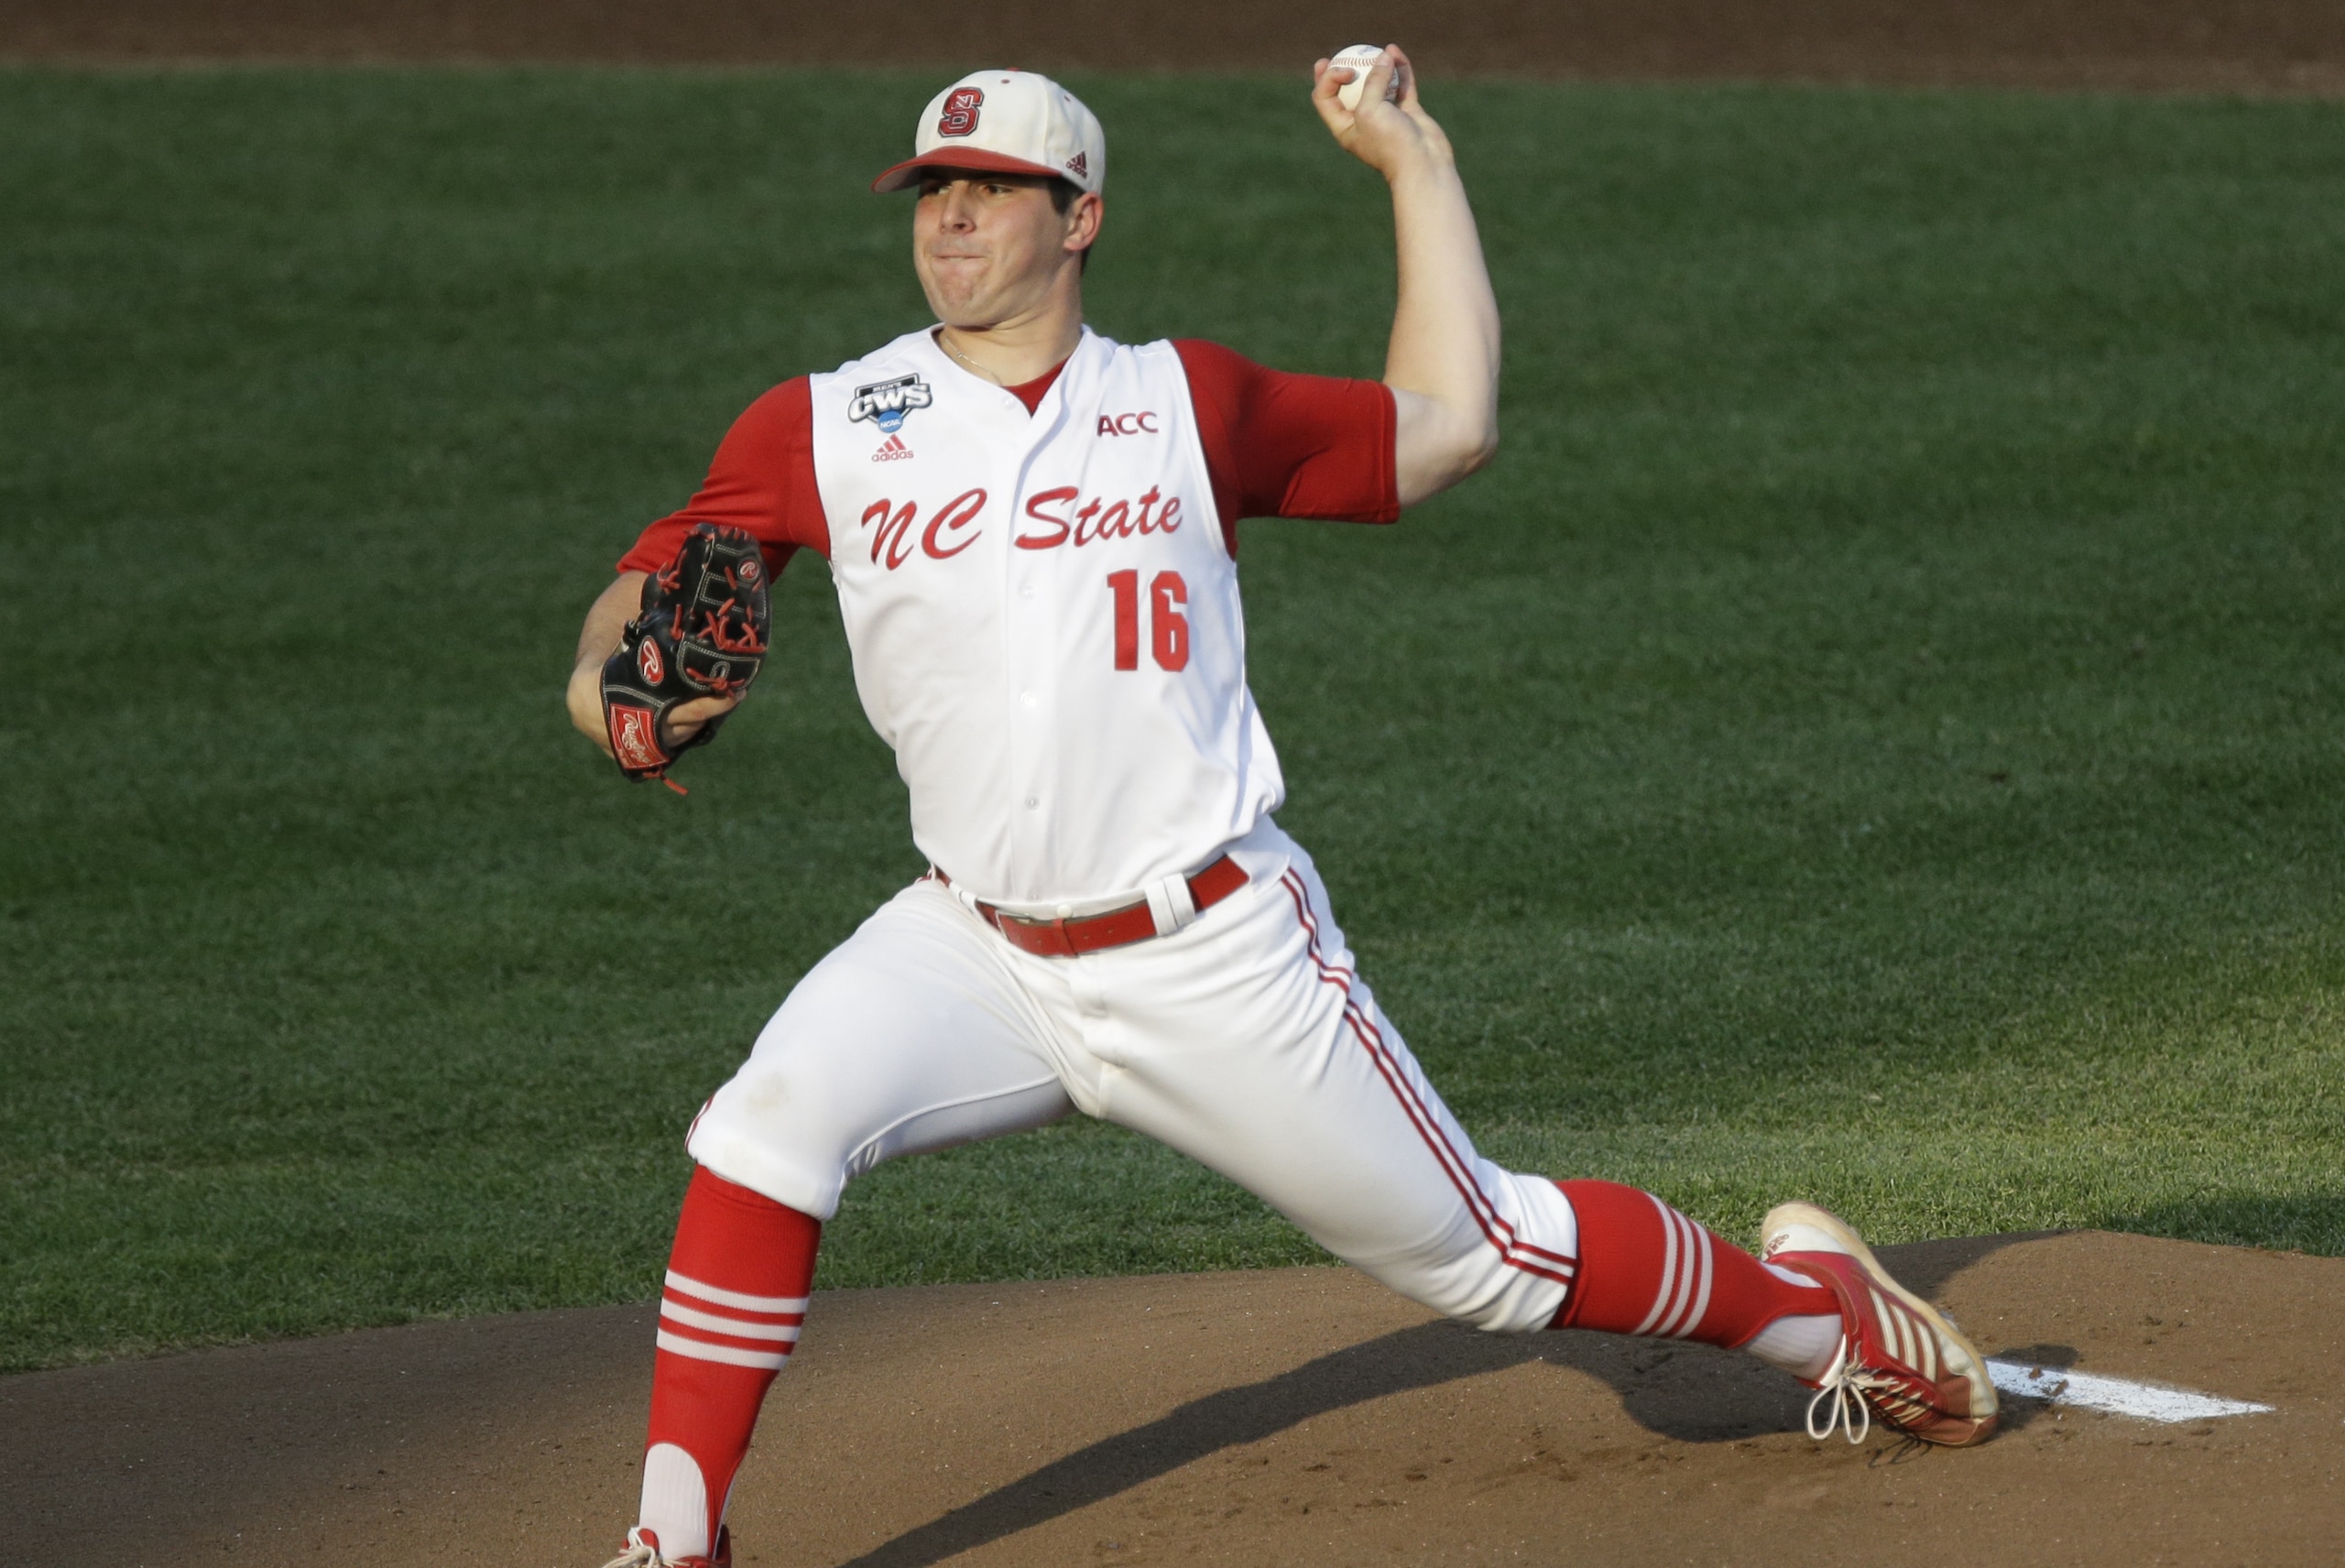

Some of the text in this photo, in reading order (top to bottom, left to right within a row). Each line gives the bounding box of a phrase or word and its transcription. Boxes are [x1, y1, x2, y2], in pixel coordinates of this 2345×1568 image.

[848, 383, 933, 423] CWS
[880, 419, 901, 429] NCAA
[1097, 411, 1159, 437] ACC
[871, 450, 914, 463] adidas
[1014, 485, 1183, 550] State
[1107, 569, 1189, 672] 16
